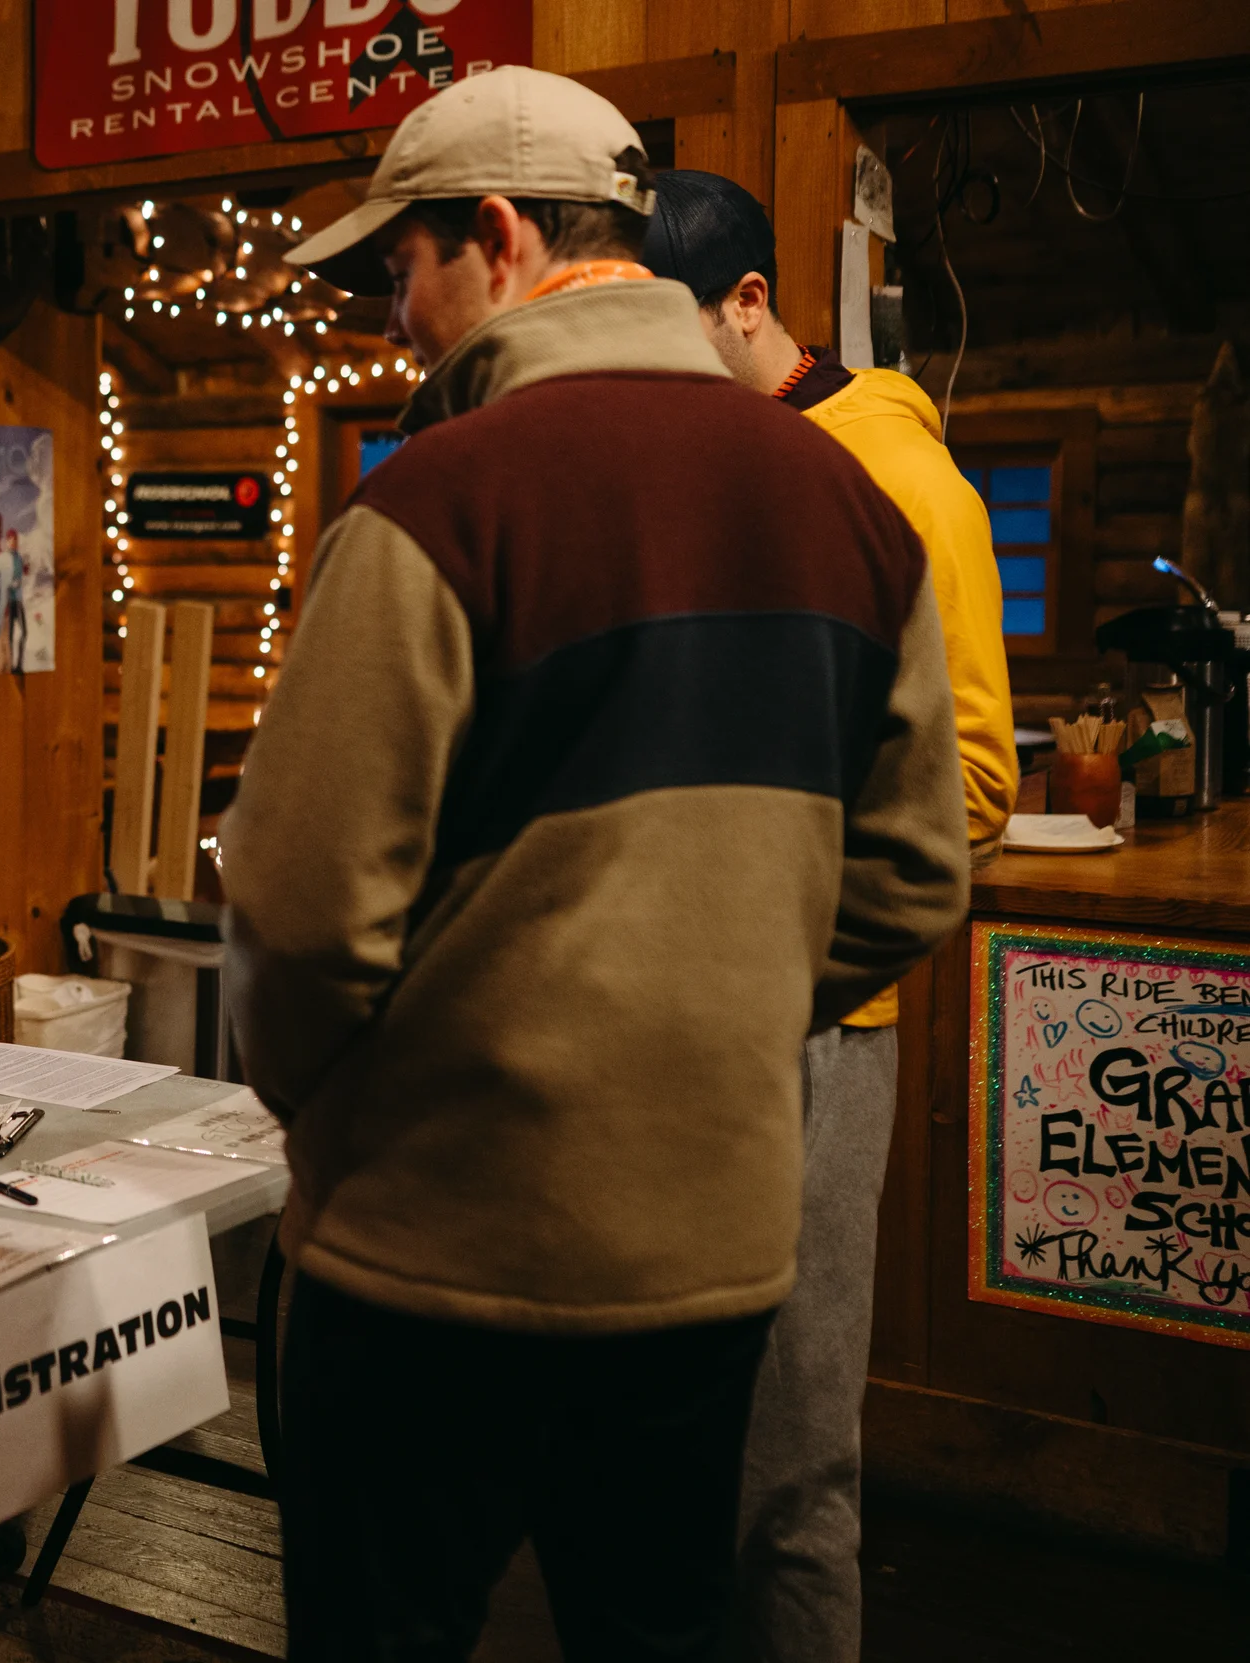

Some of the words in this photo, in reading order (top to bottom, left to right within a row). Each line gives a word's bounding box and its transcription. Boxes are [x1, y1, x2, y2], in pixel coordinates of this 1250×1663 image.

[111, 26, 446, 101] SNOWSHOE
[70, 97, 256, 139] RENTAL
[1100, 972, 1184, 1004] RIDE
